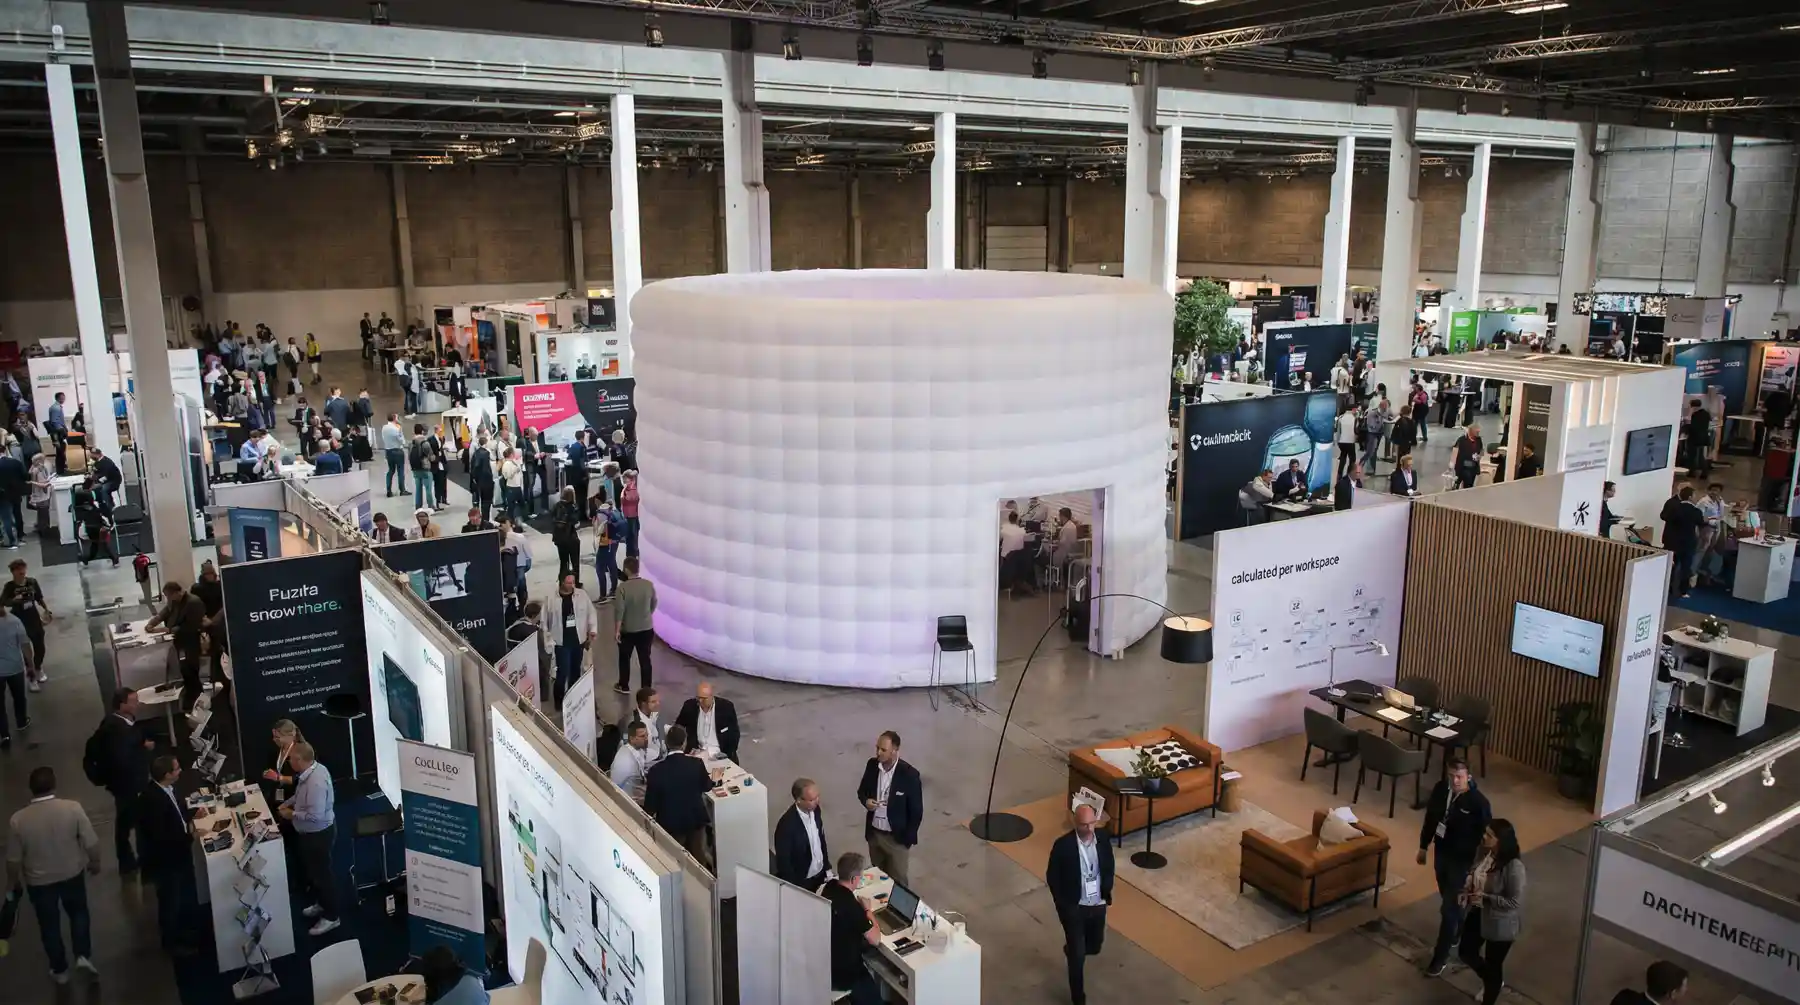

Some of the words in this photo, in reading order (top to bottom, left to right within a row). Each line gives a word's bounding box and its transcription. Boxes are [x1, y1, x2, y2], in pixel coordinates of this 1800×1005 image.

[1231, 565, 1278, 585] calculated
[1278, 564, 1294, 579] per
[1295, 555, 1340, 573] workspace
